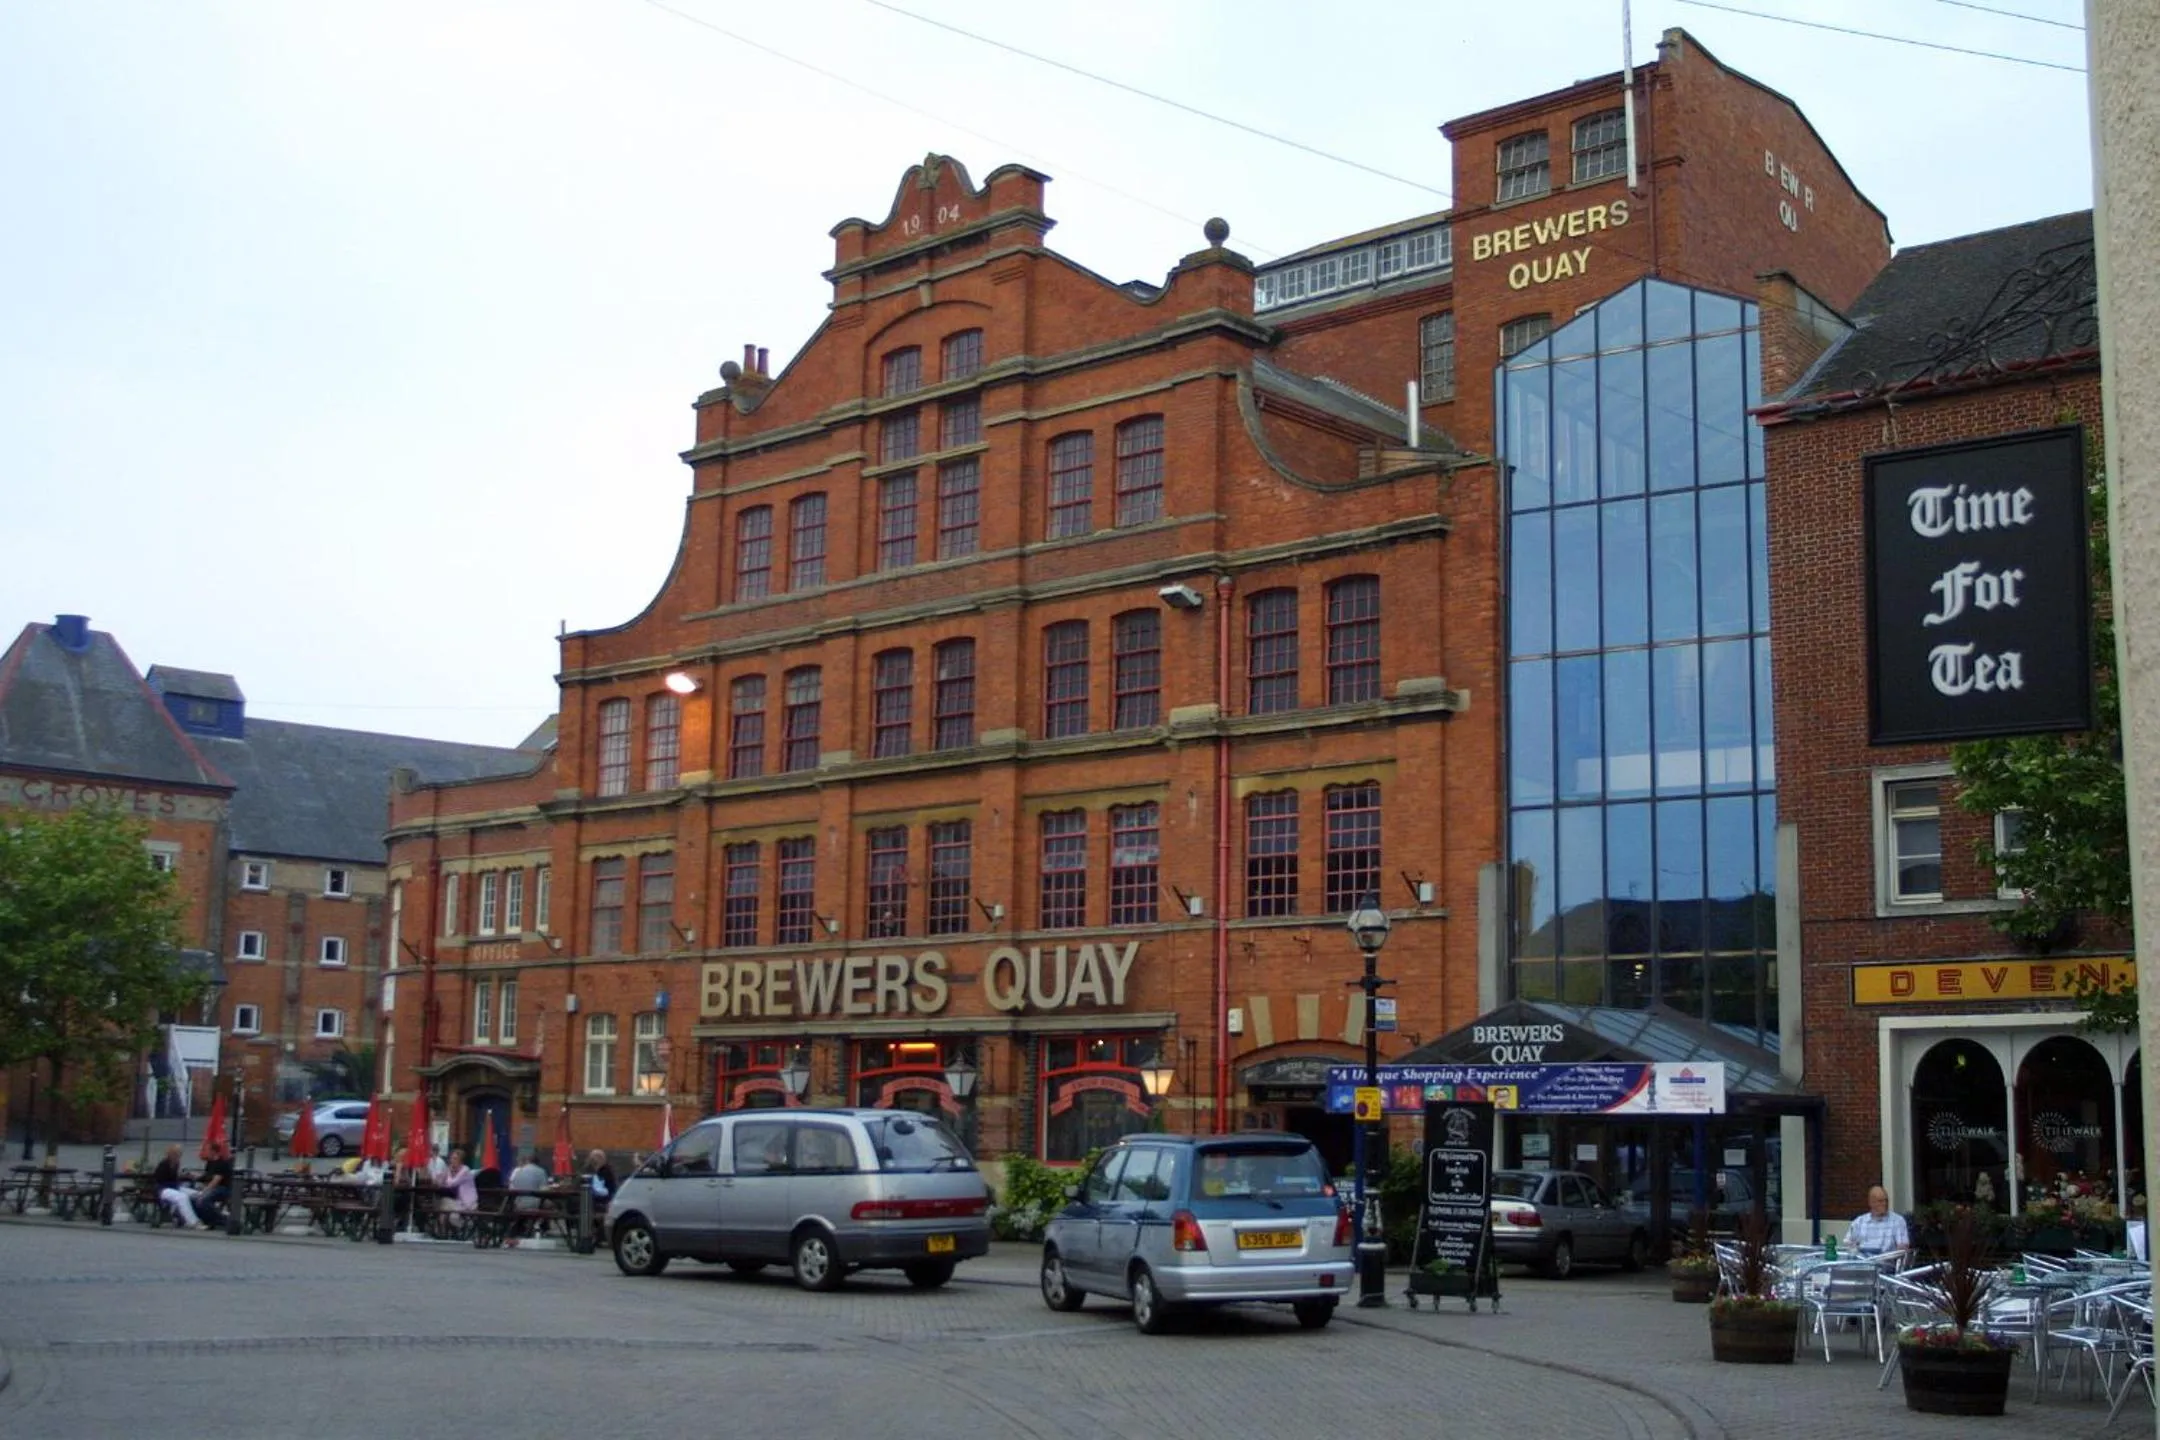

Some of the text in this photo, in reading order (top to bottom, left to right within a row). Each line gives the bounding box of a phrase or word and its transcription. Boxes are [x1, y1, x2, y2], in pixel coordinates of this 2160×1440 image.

[1472, 200, 1629, 261] BREWERS
[1508, 246, 1592, 290] QUAY
[1907, 484, 2036, 537] Time
[1923, 561, 2026, 627] For
[1928, 642, 2024, 696] Tea
[473, 943, 521, 961] OFFICE
[701, 941, 1140, 1017] BREWERS QUAY
[1473, 1024, 1564, 1043] BREWERS
[1491, 1045, 1545, 1065] QUAY
[1352, 1069, 1399, 1084] Uque
[1401, 1068, 1463, 1083] Shopping
[1466, 1068, 1546, 1083] Experience"
